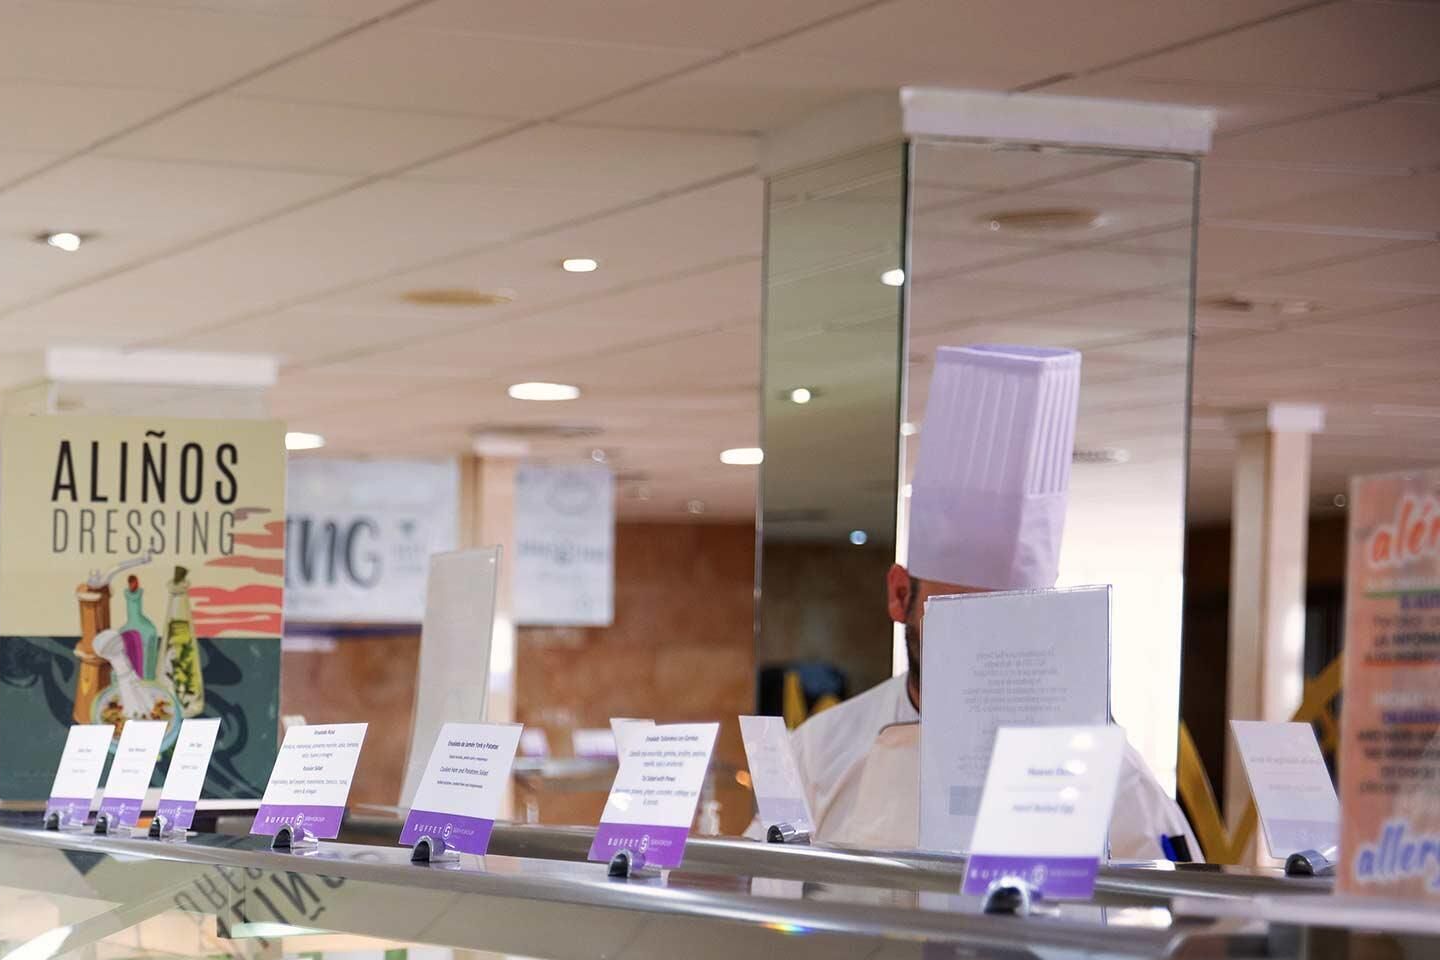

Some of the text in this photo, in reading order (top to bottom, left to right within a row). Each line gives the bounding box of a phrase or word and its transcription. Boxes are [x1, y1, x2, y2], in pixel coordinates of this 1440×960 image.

[51, 430, 238, 505] ALIÑOS
[52, 508, 235, 556] DRESSING
[413, 823, 442, 835] BUFFET
[607, 837, 639, 848] BUFFET
